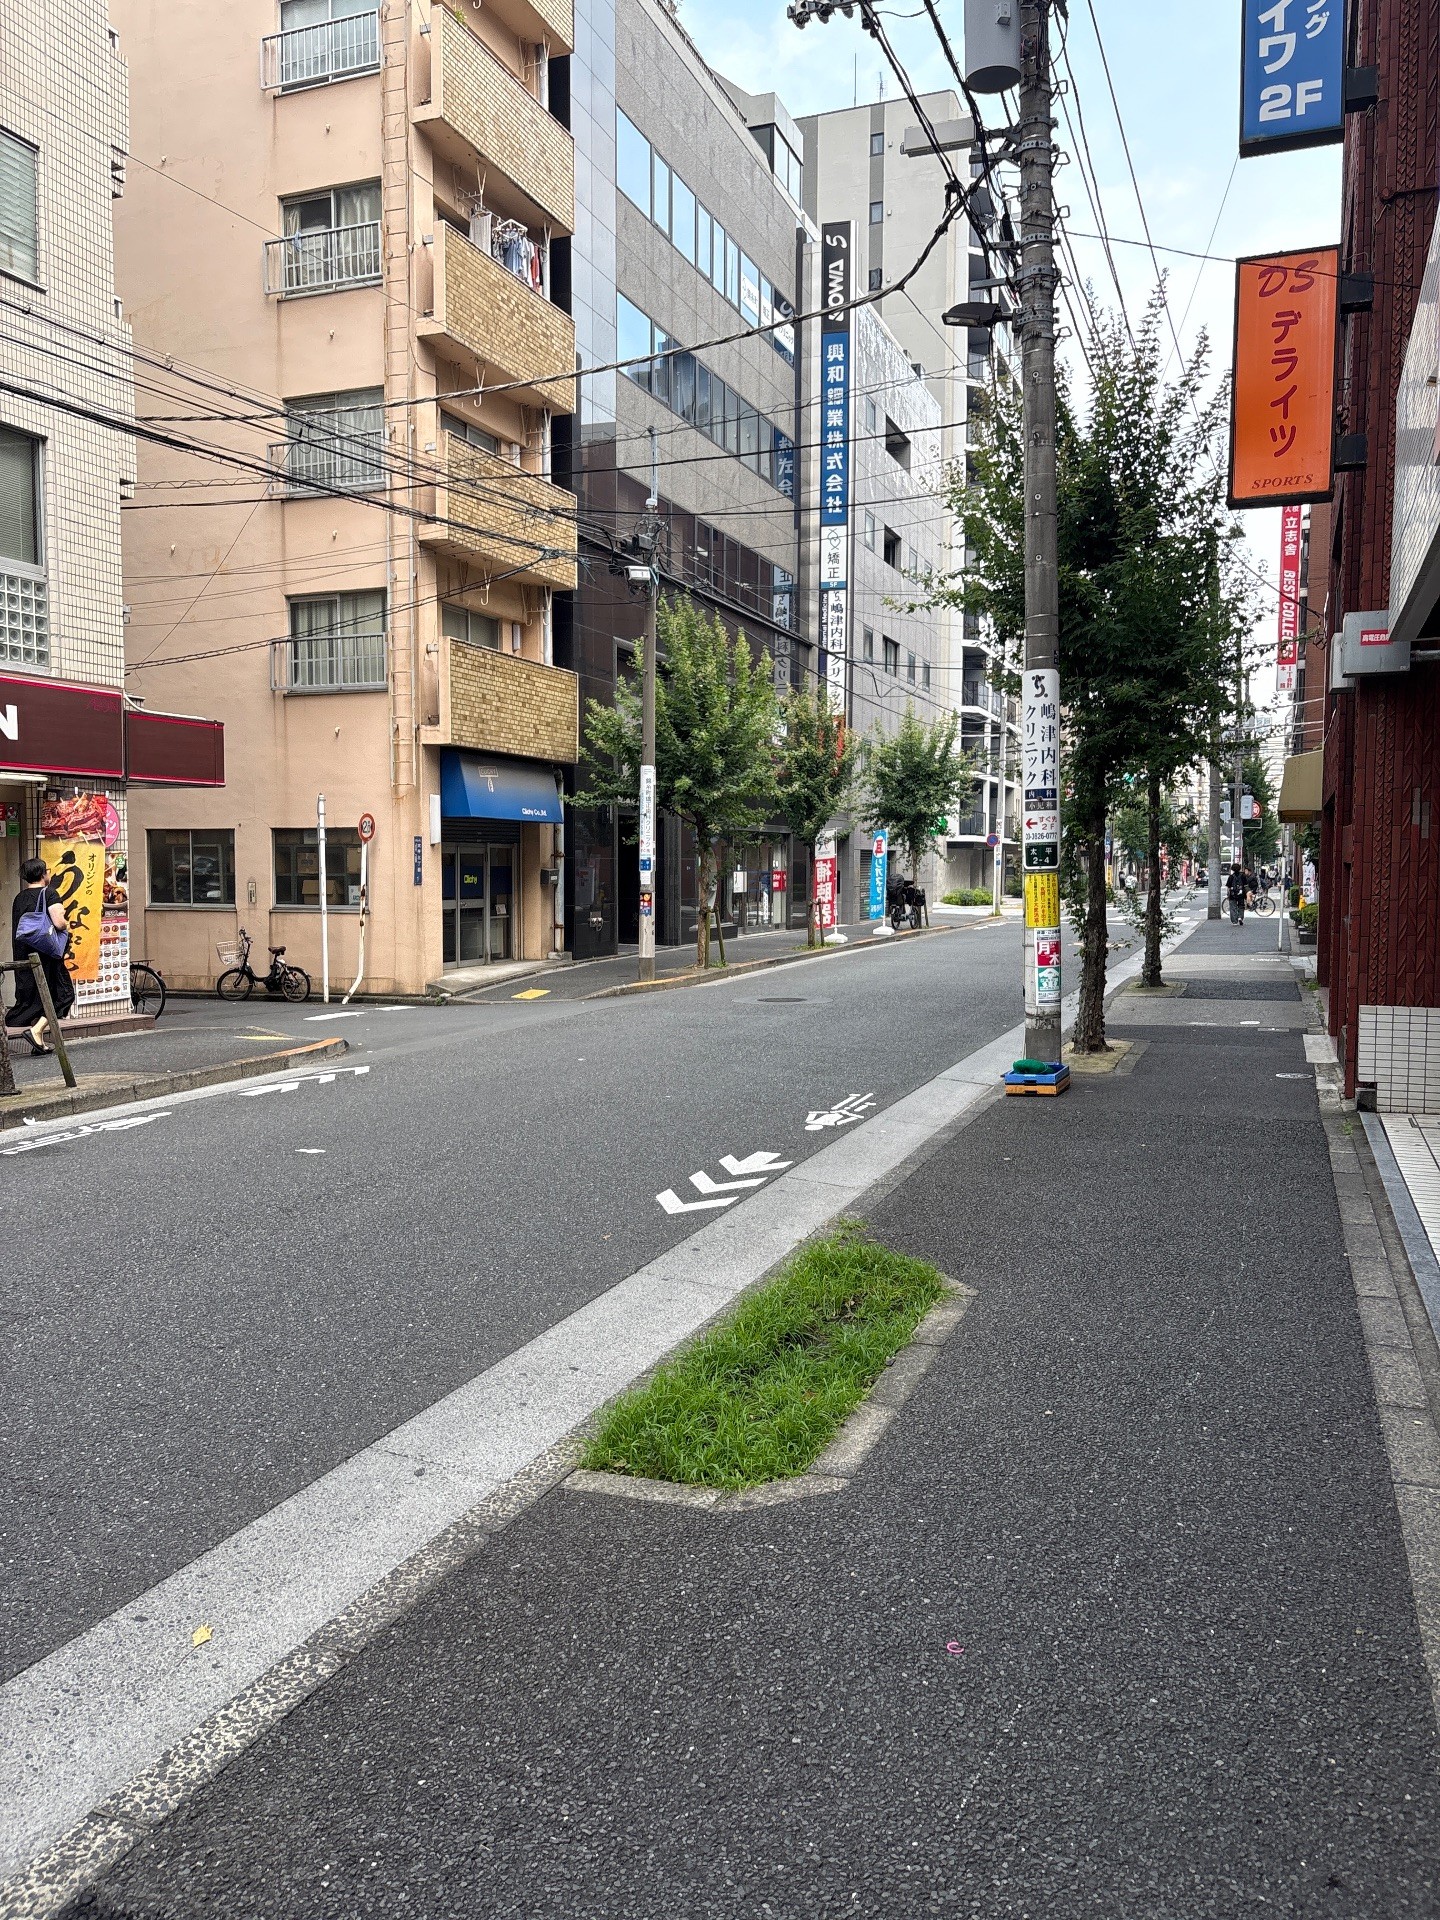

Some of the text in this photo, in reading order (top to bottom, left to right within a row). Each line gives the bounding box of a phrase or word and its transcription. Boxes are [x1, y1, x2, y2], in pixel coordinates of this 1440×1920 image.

[1259, 79, 1323, 122] 2F
[1258, 260, 1319, 298] DS
[1269, 310, 1302, 458] デライツ
[1251, 473, 1314, 490] SPORTS
[1284, 516, 1298, 556] 立志舎
[827, 551, 841, 579] 矯正
[1283, 570, 1296, 600] BEST
[821, 593, 829, 623] Medicine
[830, 603, 844, 650] 嶋津内科
[1024, 704, 1038, 787] クリニック
[1040, 702, 1057, 787] 嶋津内科
[85, 853, 97, 896] オリジンの
[1032, 856, 1050, 865] 2-4
[1038, 942, 1050, 955] 月
